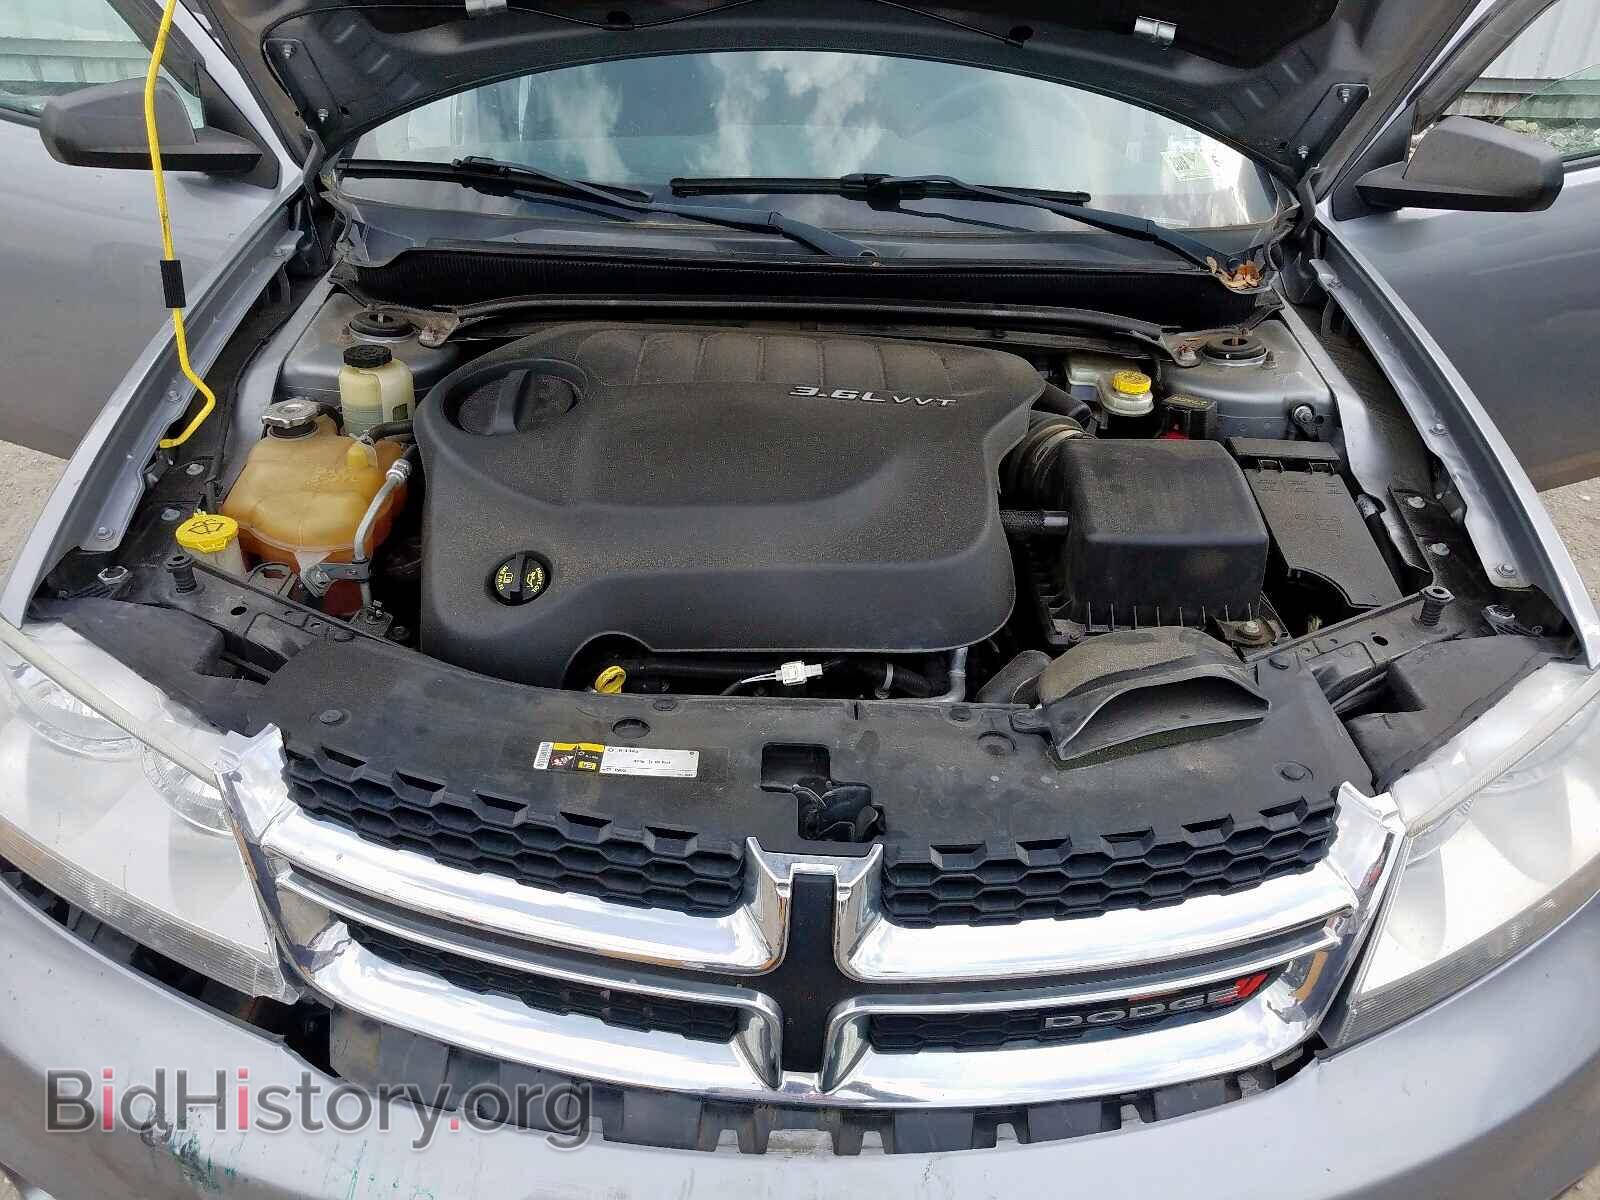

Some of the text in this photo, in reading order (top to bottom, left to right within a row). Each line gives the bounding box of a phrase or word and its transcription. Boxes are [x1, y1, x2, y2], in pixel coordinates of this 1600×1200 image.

[789, 386, 957, 407] 3.6L VVT
[1043, 983, 1239, 1030] DODGE
